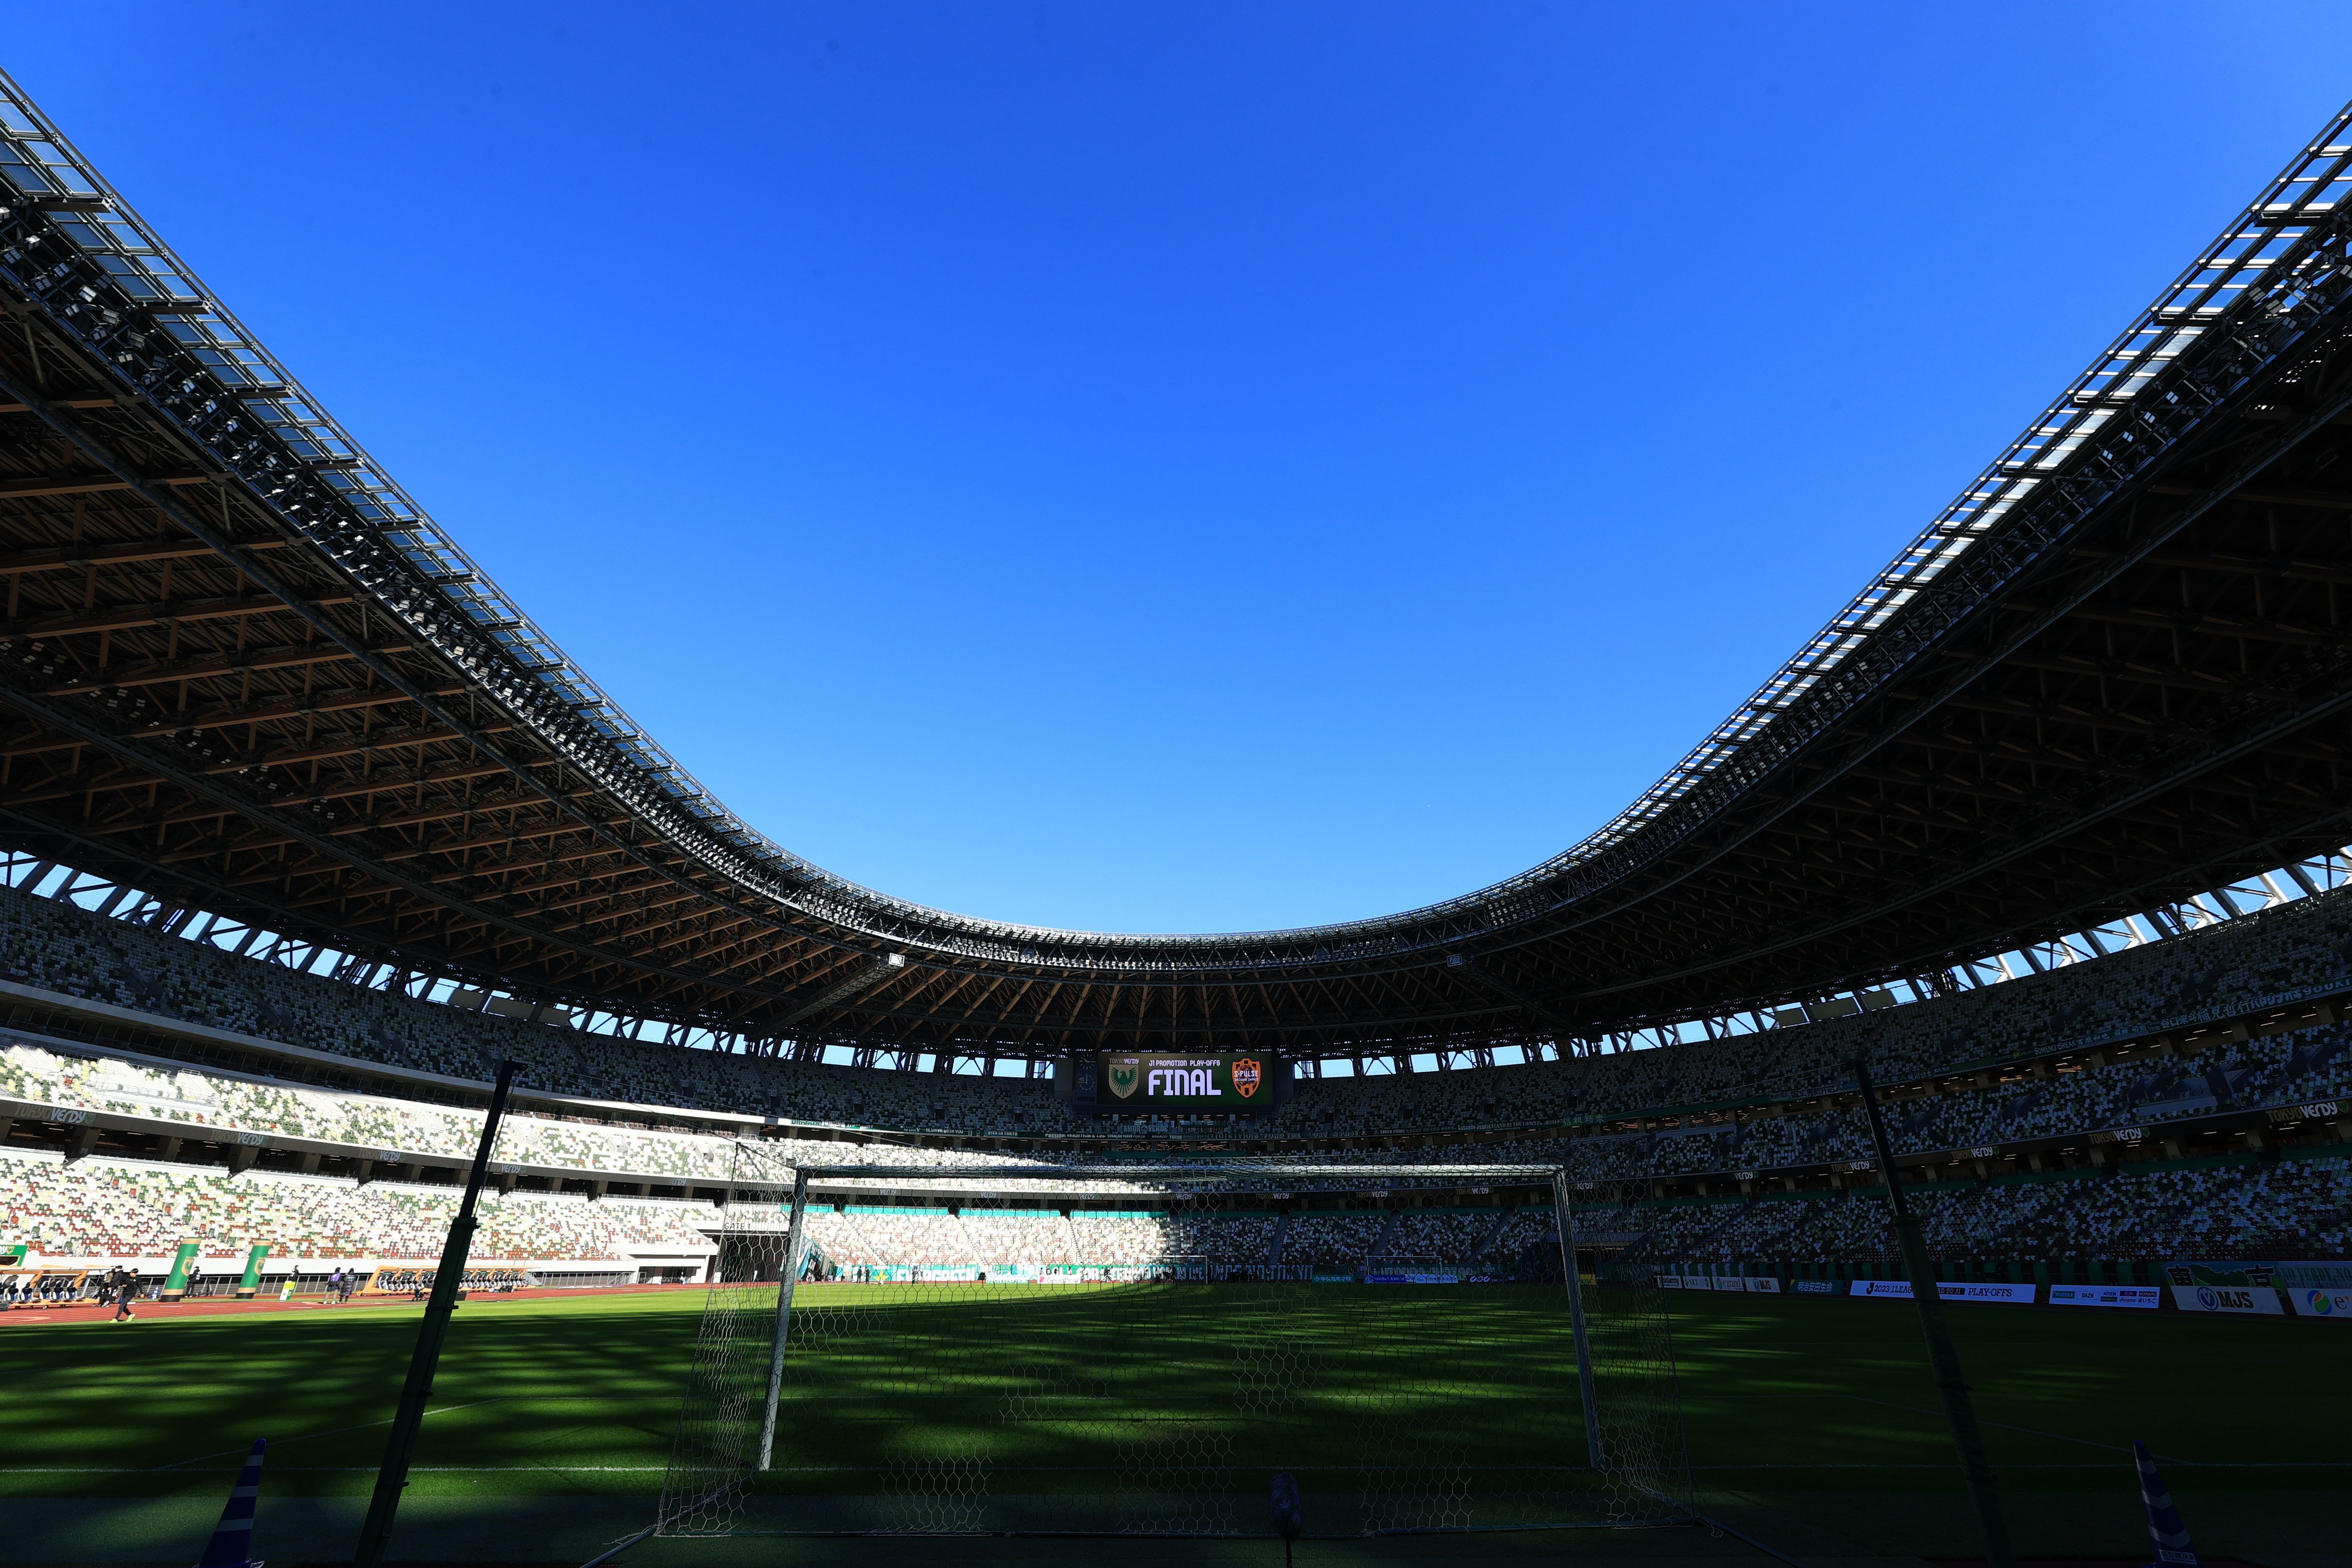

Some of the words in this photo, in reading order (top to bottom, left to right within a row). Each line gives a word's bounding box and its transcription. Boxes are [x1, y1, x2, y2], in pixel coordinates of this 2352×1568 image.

[2033, 1044, 2056, 1055] SOMENO
[2057, 1040, 2076, 1050] BREAK
[1148, 1069, 1222, 1096] FINAL
[1759, 1280, 1772, 1290] MJS
[1797, 1282, 1833, 1292] 明治安田生命
[1968, 1287, 2012, 1297] PLAY-OFFS
[2216, 1291, 2254, 1309] MJS
